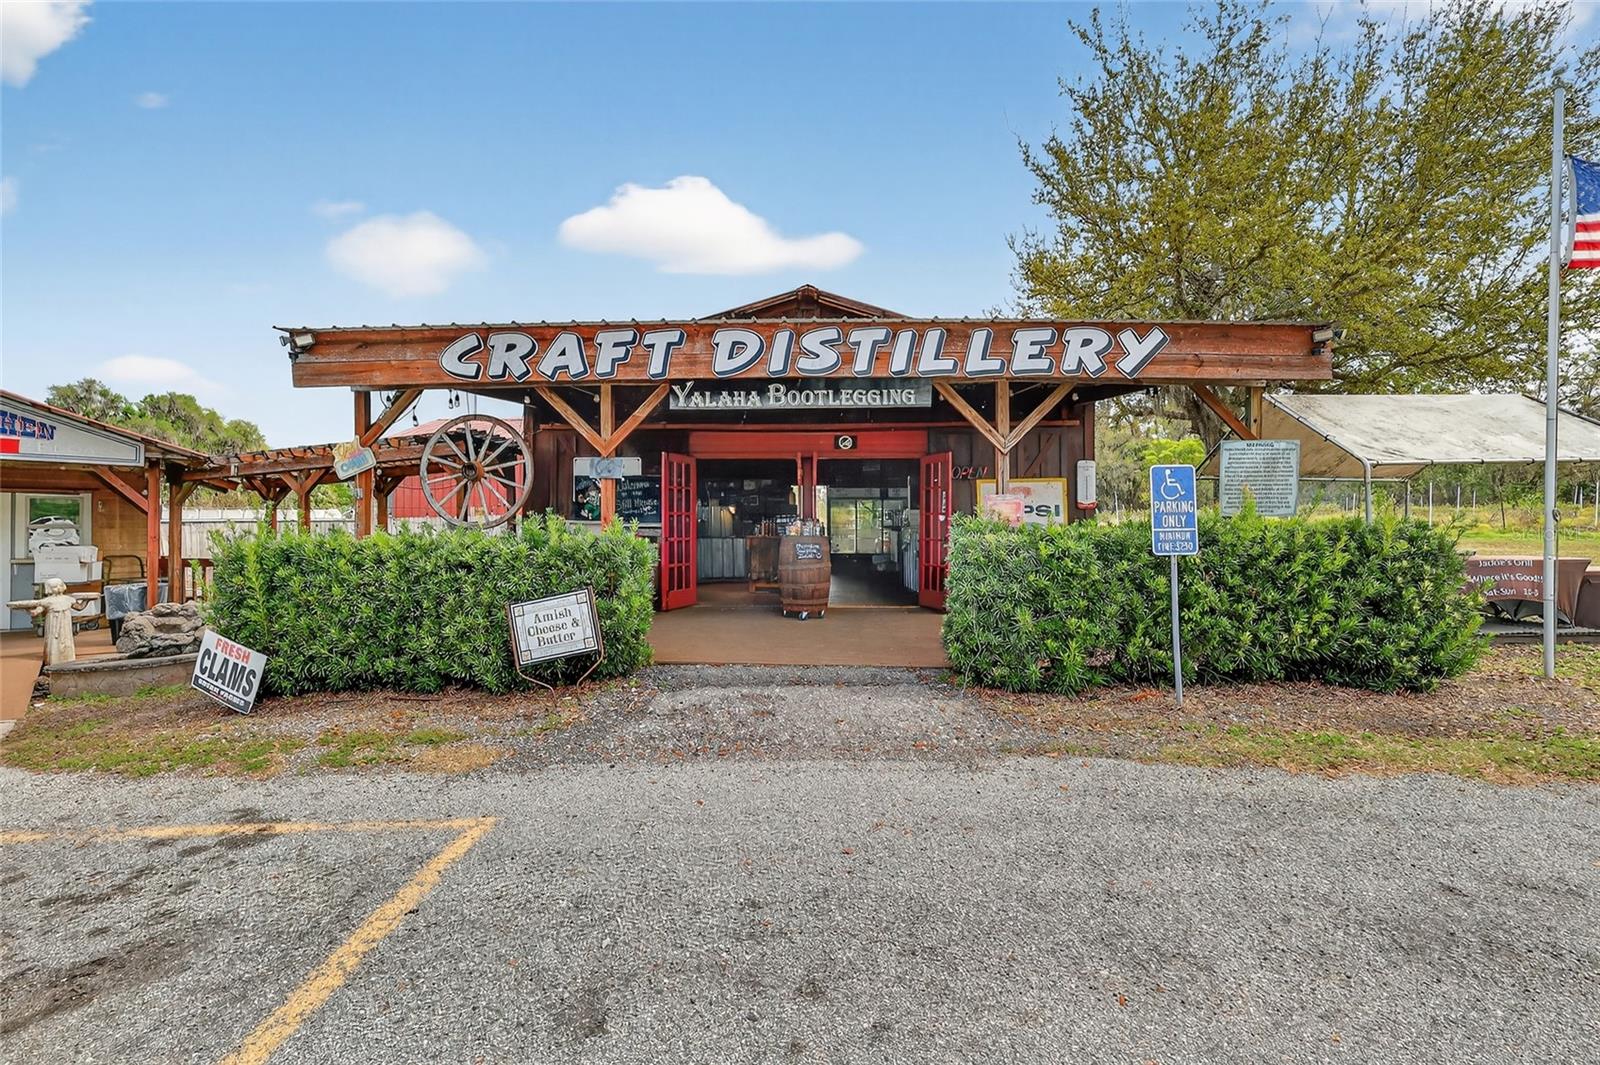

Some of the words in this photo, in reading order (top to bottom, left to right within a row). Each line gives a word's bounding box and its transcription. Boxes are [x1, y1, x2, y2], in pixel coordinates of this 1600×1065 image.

[438, 328, 687, 383] CRAFT
[711, 326, 1170, 379] DISTILLERY
[951, 466, 988, 479] OPEN
[1154, 501, 1194, 513] PARKING
[1162, 515, 1187, 528] ONLY
[534, 608, 572, 624] Amish
[527, 621, 568, 637] Cheese
[571, 617, 580, 628] &
[536, 632, 576, 647] Butter
[215, 638, 251, 665] FRESH
[199, 647, 257, 698] CLAMS
